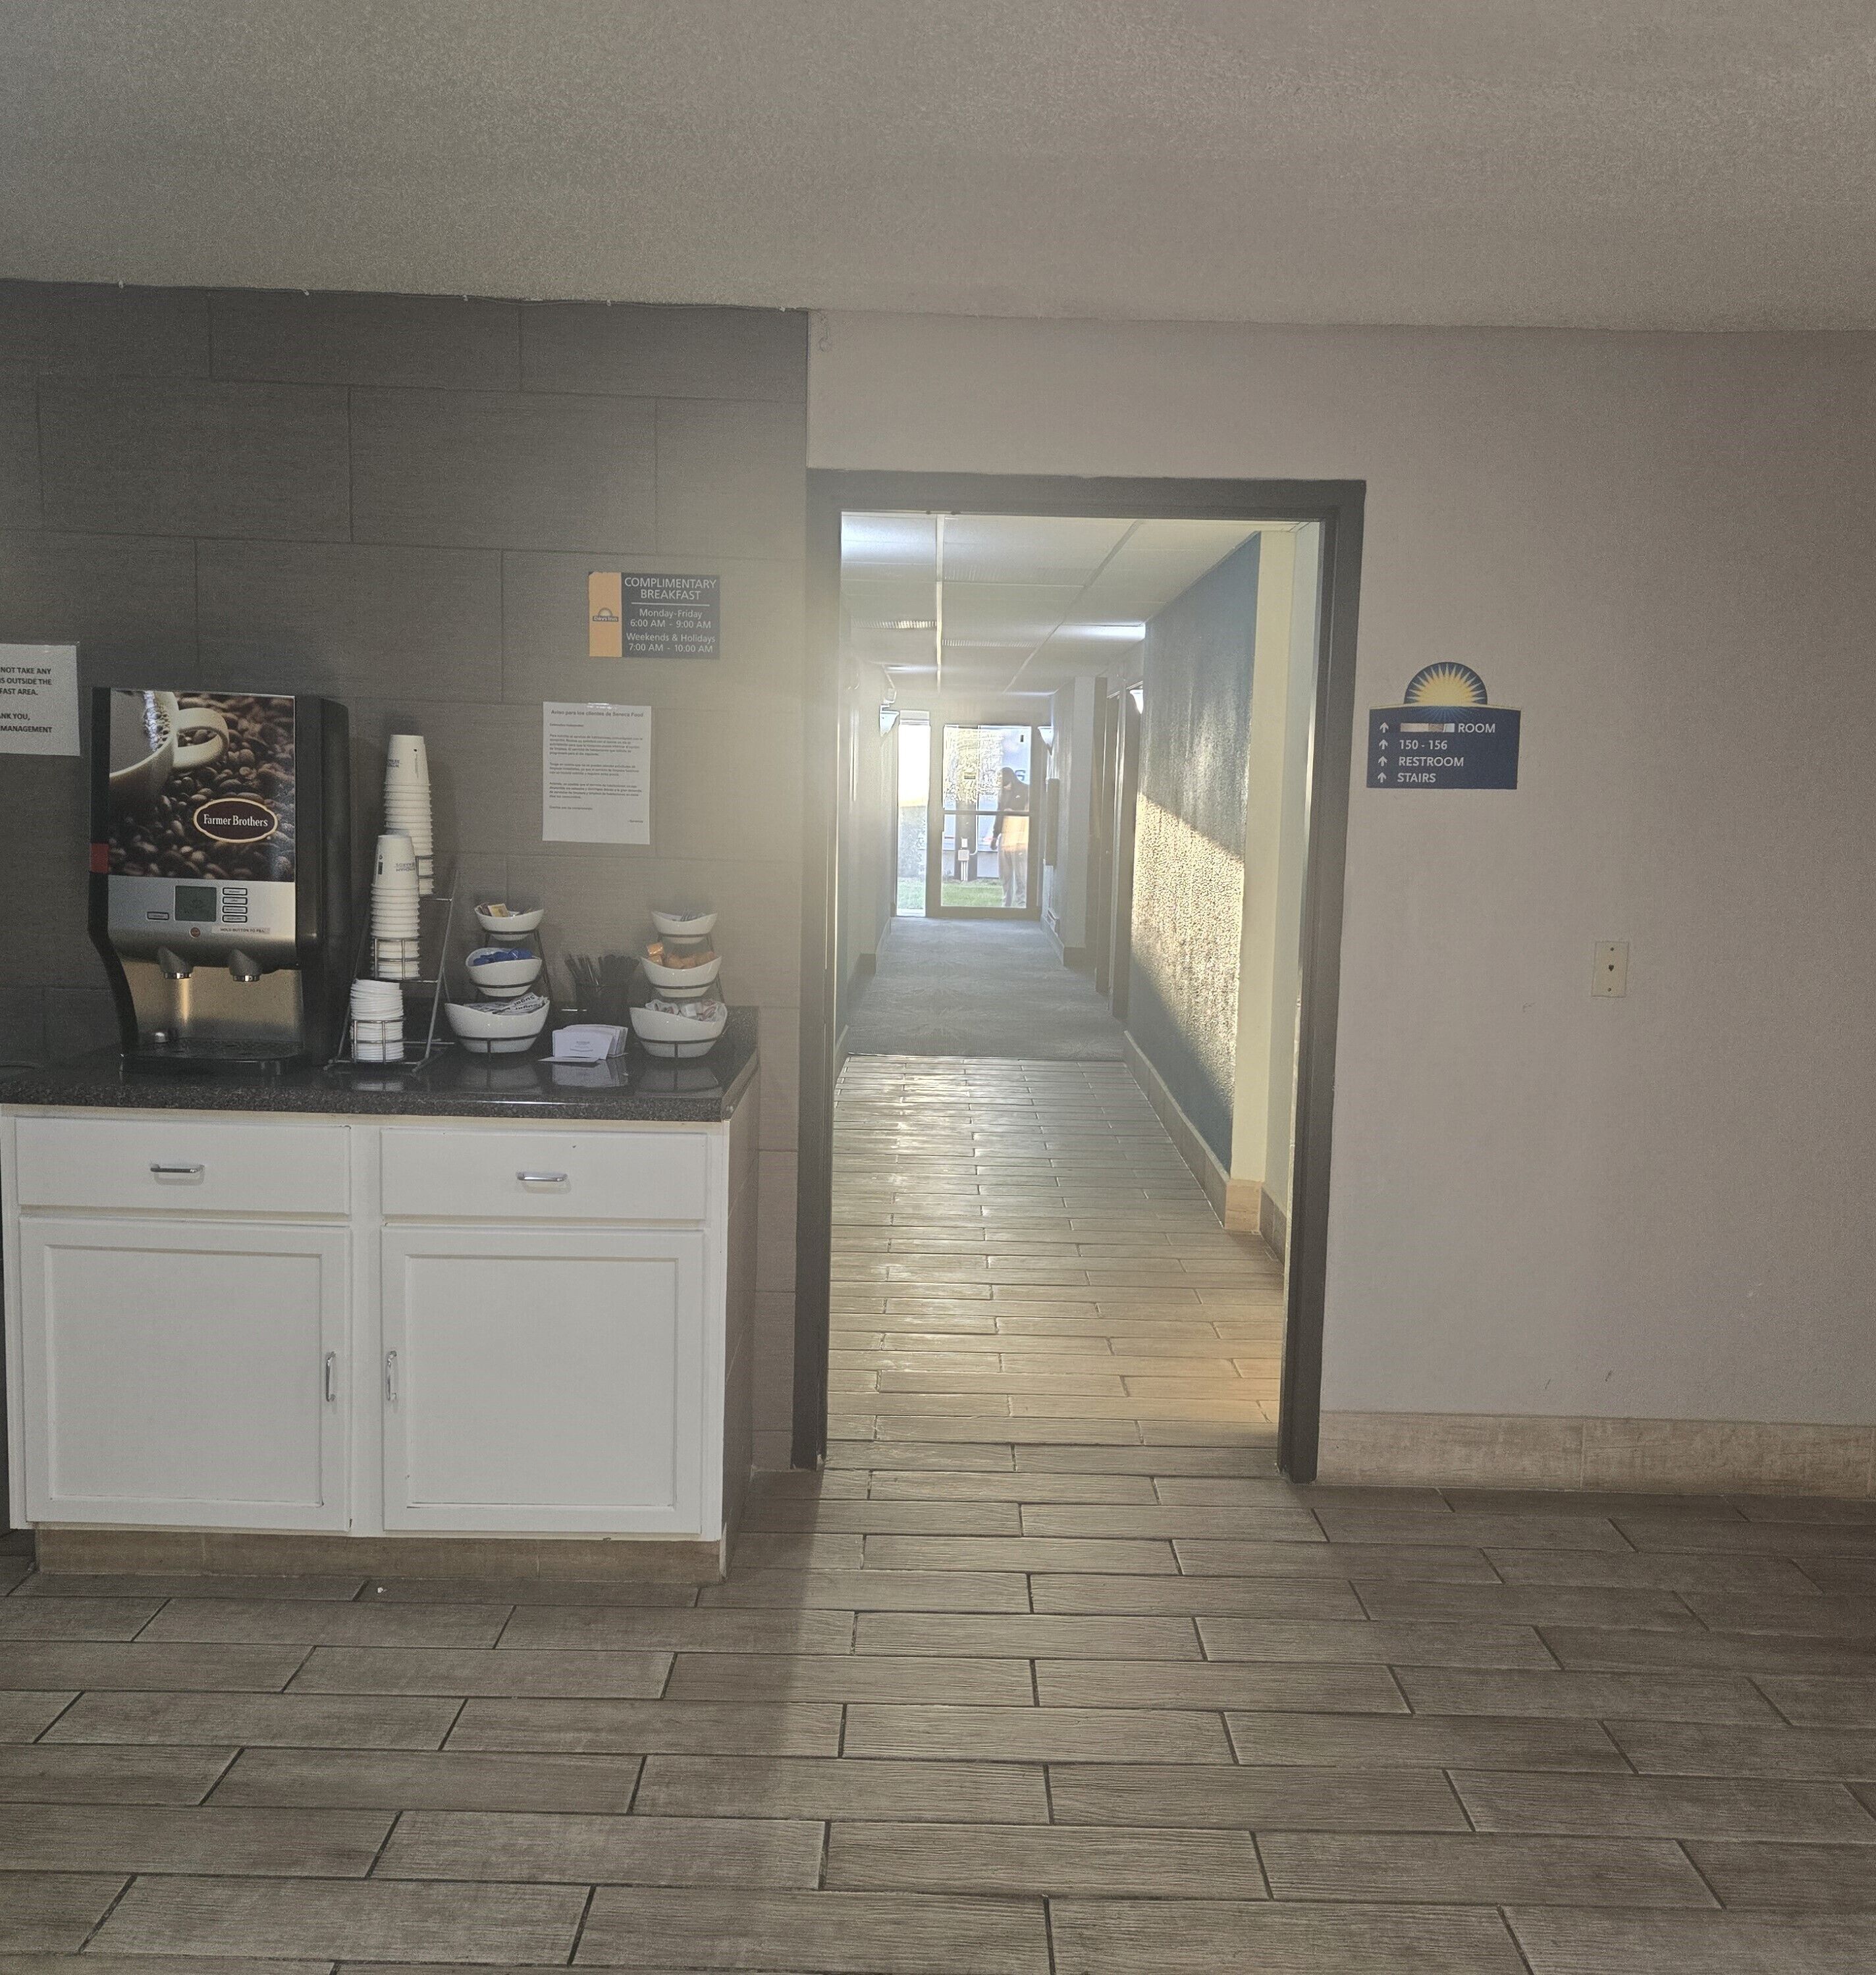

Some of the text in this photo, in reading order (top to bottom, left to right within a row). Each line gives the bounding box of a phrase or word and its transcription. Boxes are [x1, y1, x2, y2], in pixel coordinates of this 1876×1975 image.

[625, 577, 717, 589] COMPLIMENTARY
[641, 589, 701, 600] BREAKFAST
[630, 619, 649, 627] 6:00
[676, 619, 694, 628] 9:00
[626, 632, 668, 641] Weekends
[681, 634, 716, 643] Holidays
[1458, 723, 1495, 733] ROOM
[1399, 740, 1418, 750] 150
[1429, 740, 1447, 750] 156
[1399, 756, 1464, 766] RESTROOM
[1397, 773, 1436, 783] STAIRS
[203, 814, 268, 827] Farmer Brothers
[514, 995, 535, 1007] Sugar
